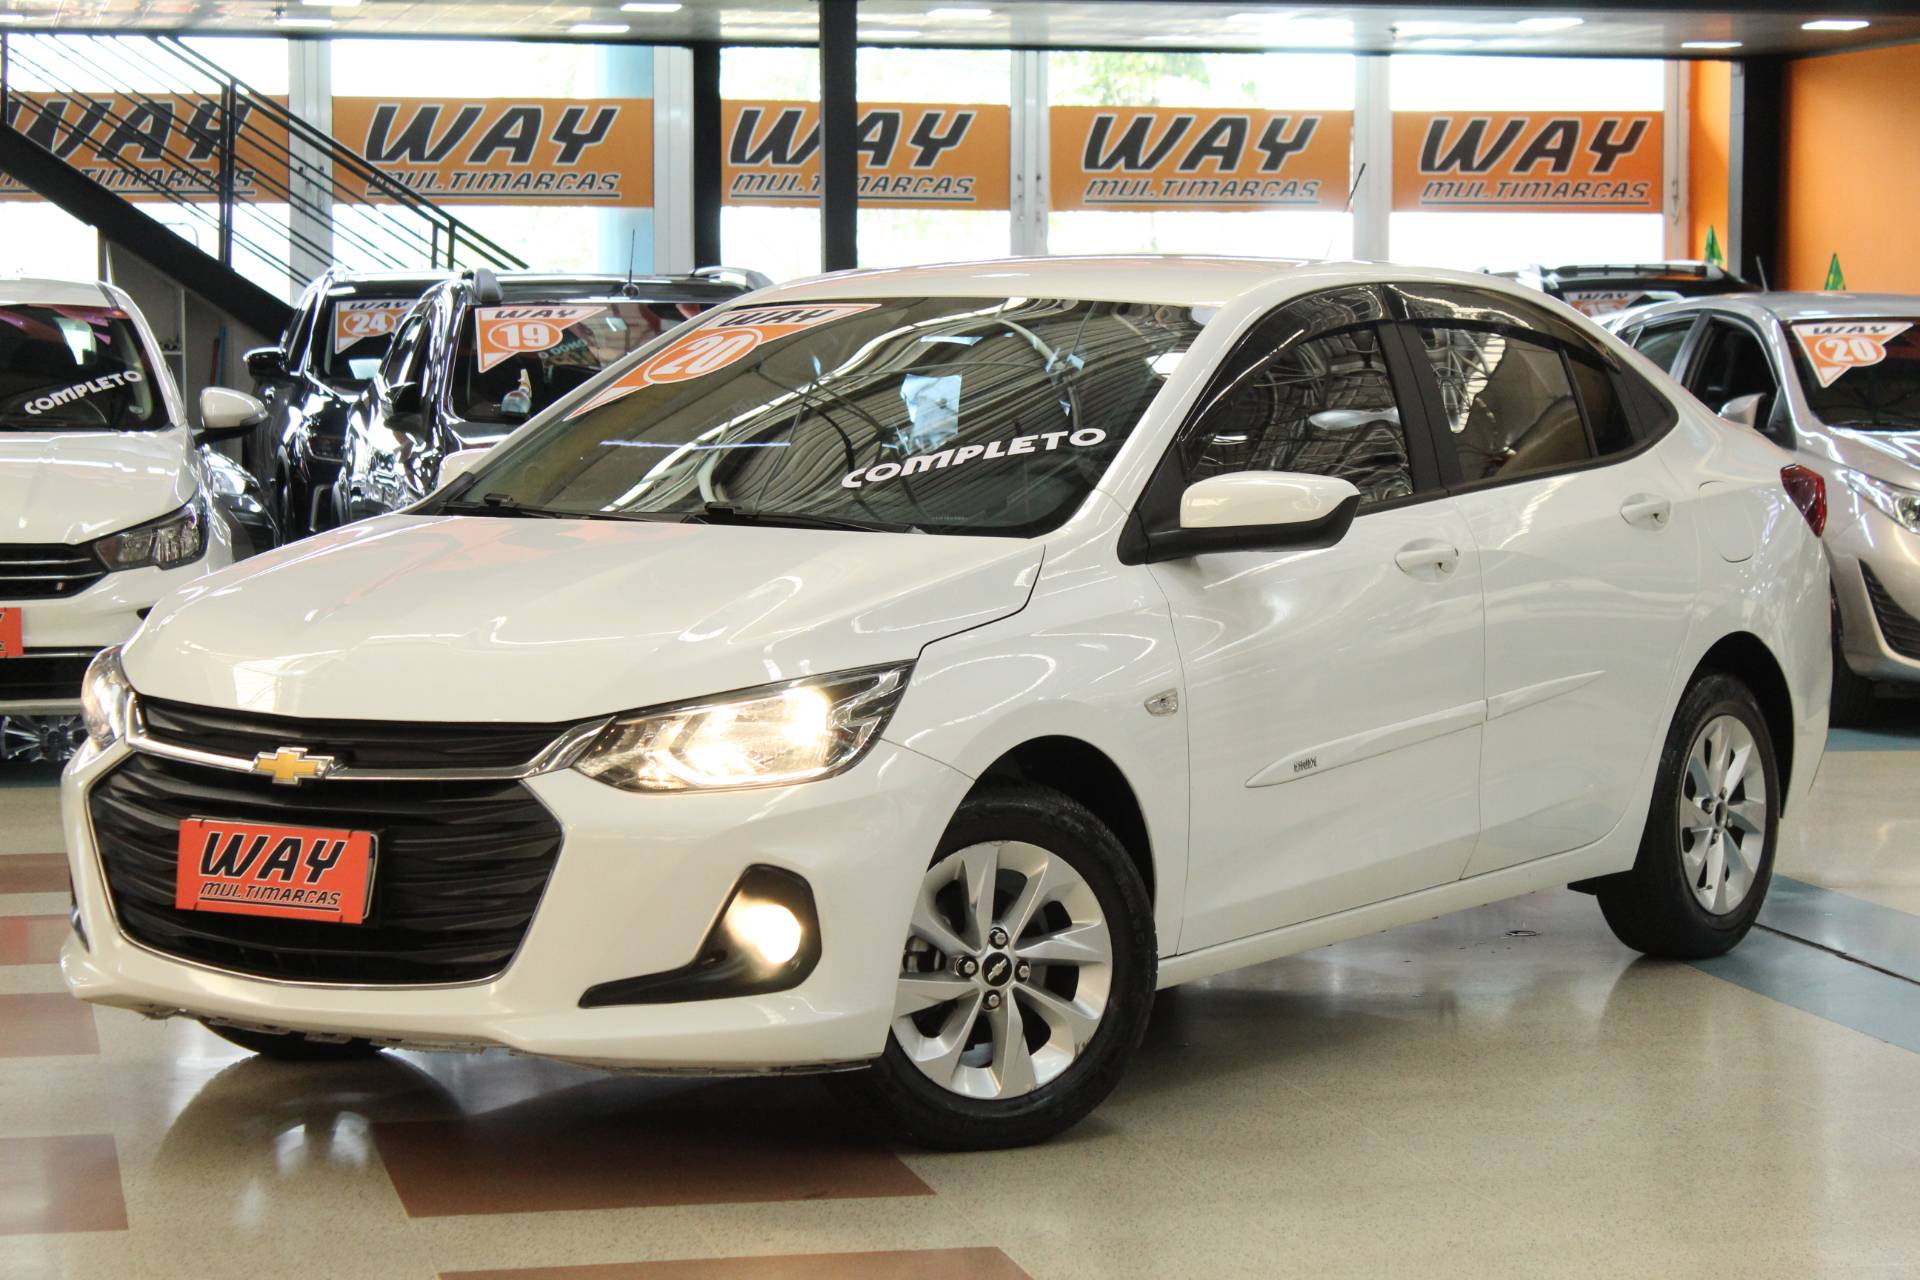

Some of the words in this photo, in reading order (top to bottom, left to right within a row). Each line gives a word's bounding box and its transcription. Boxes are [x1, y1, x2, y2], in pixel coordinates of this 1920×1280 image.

[365, 104, 621, 166] WAY
[728, 106, 976, 169] WAY
[1082, 114, 1321, 173] WAY
[1418, 117, 1651, 175] WAY
[731, 173, 976, 194] MULTARCAS
[1085, 178, 1322, 197] MULTIMARCAS
[1421, 180, 1650, 198] MULTIMARCAS
[494, 309, 577, 319] WAY
[720, 308, 836, 327] WAY
[499, 323, 550, 347] 19
[1813, 326, 1887, 334] WAY
[650, 334, 755, 376] 20
[1824, 338, 1878, 362] 20
[24, 370, 143, 415] COMPLETO
[841, 428, 1106, 489] COMPLETO
[199, 831, 348, 885] WAY
[200, 881, 341, 906] MULTIMARCAS
